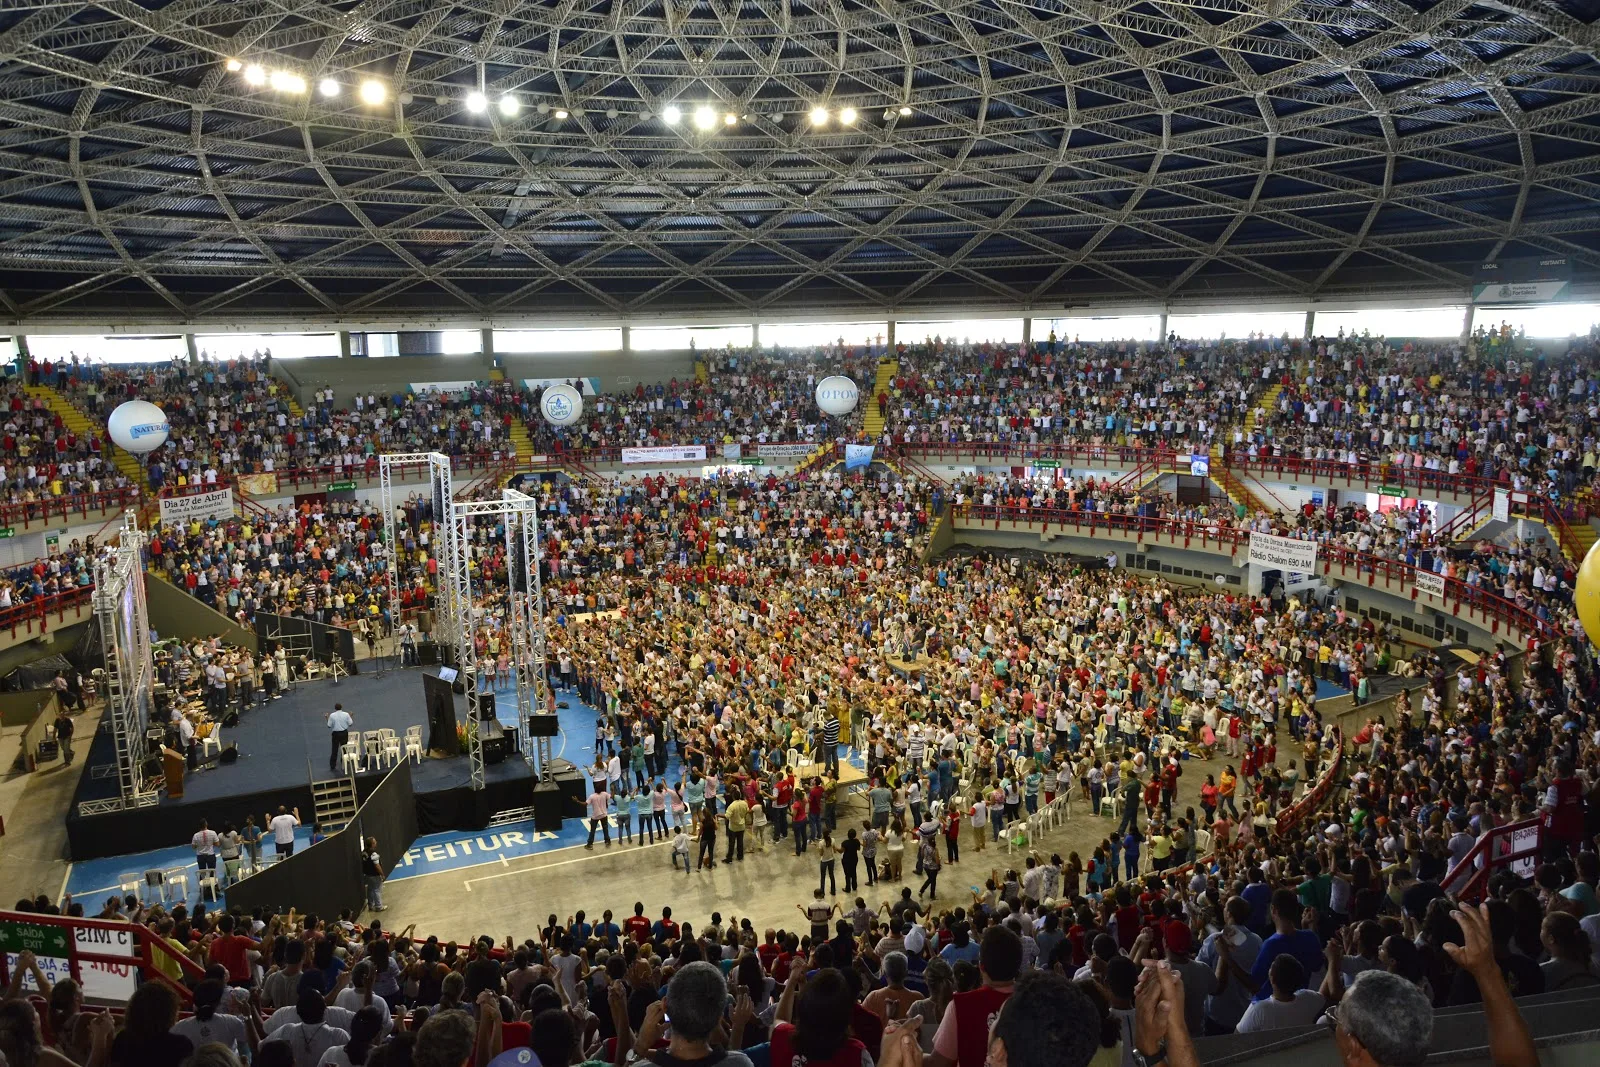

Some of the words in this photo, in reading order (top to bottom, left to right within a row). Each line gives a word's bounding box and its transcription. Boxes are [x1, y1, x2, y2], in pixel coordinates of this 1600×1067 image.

[164, 500, 178, 508] Dia
[204, 491, 227, 502] Abril
[1268, 554, 1287, 566] Shalom
[1288, 558, 1299, 566] 690
[1301, 560, 1312, 568] AM
[395, 831, 560, 868] FEITURA
[16, 927, 45, 939] SAÍDA
[24, 939, 43, 949] EXIT
